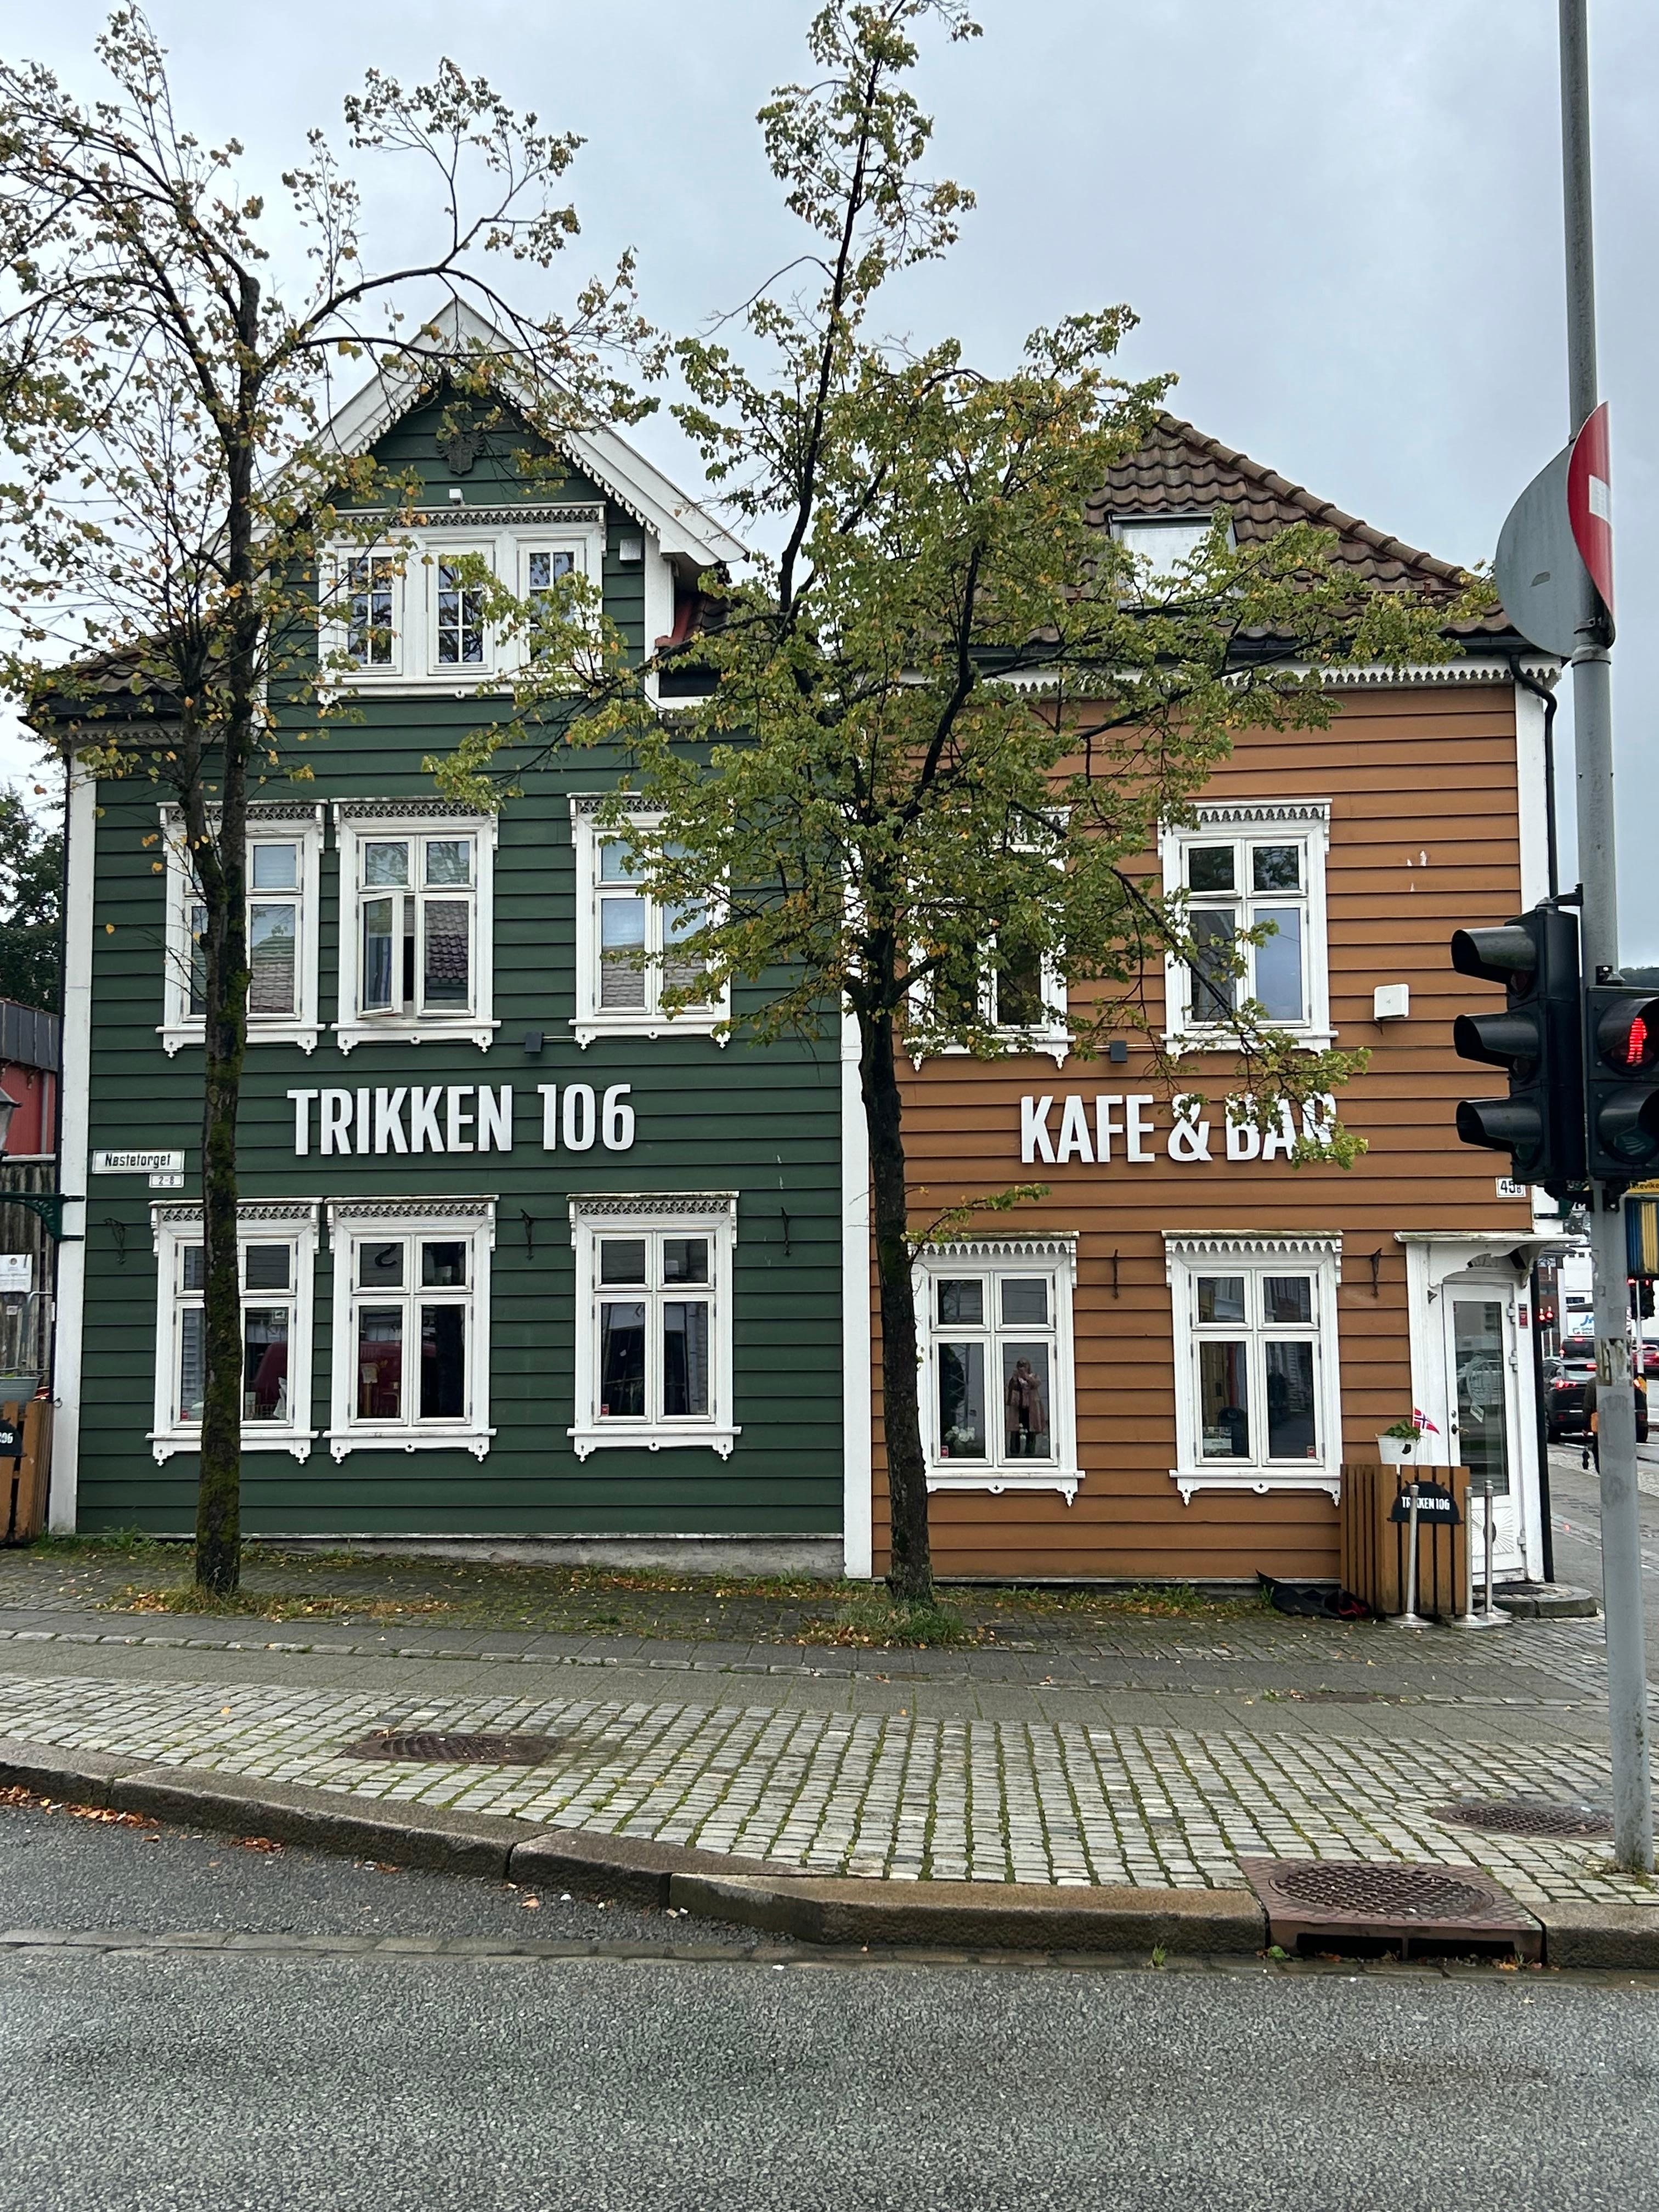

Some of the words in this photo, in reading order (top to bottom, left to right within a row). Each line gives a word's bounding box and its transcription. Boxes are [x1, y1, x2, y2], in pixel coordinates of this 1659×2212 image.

[287, 1085, 512, 1155] TRIKKEN
[537, 1084, 635, 1150] 106
[1021, 1094, 1155, 1163] KAFE
[1168, 1093, 1212, 1161] &
[1436, 1498, 1450, 1510] 106
